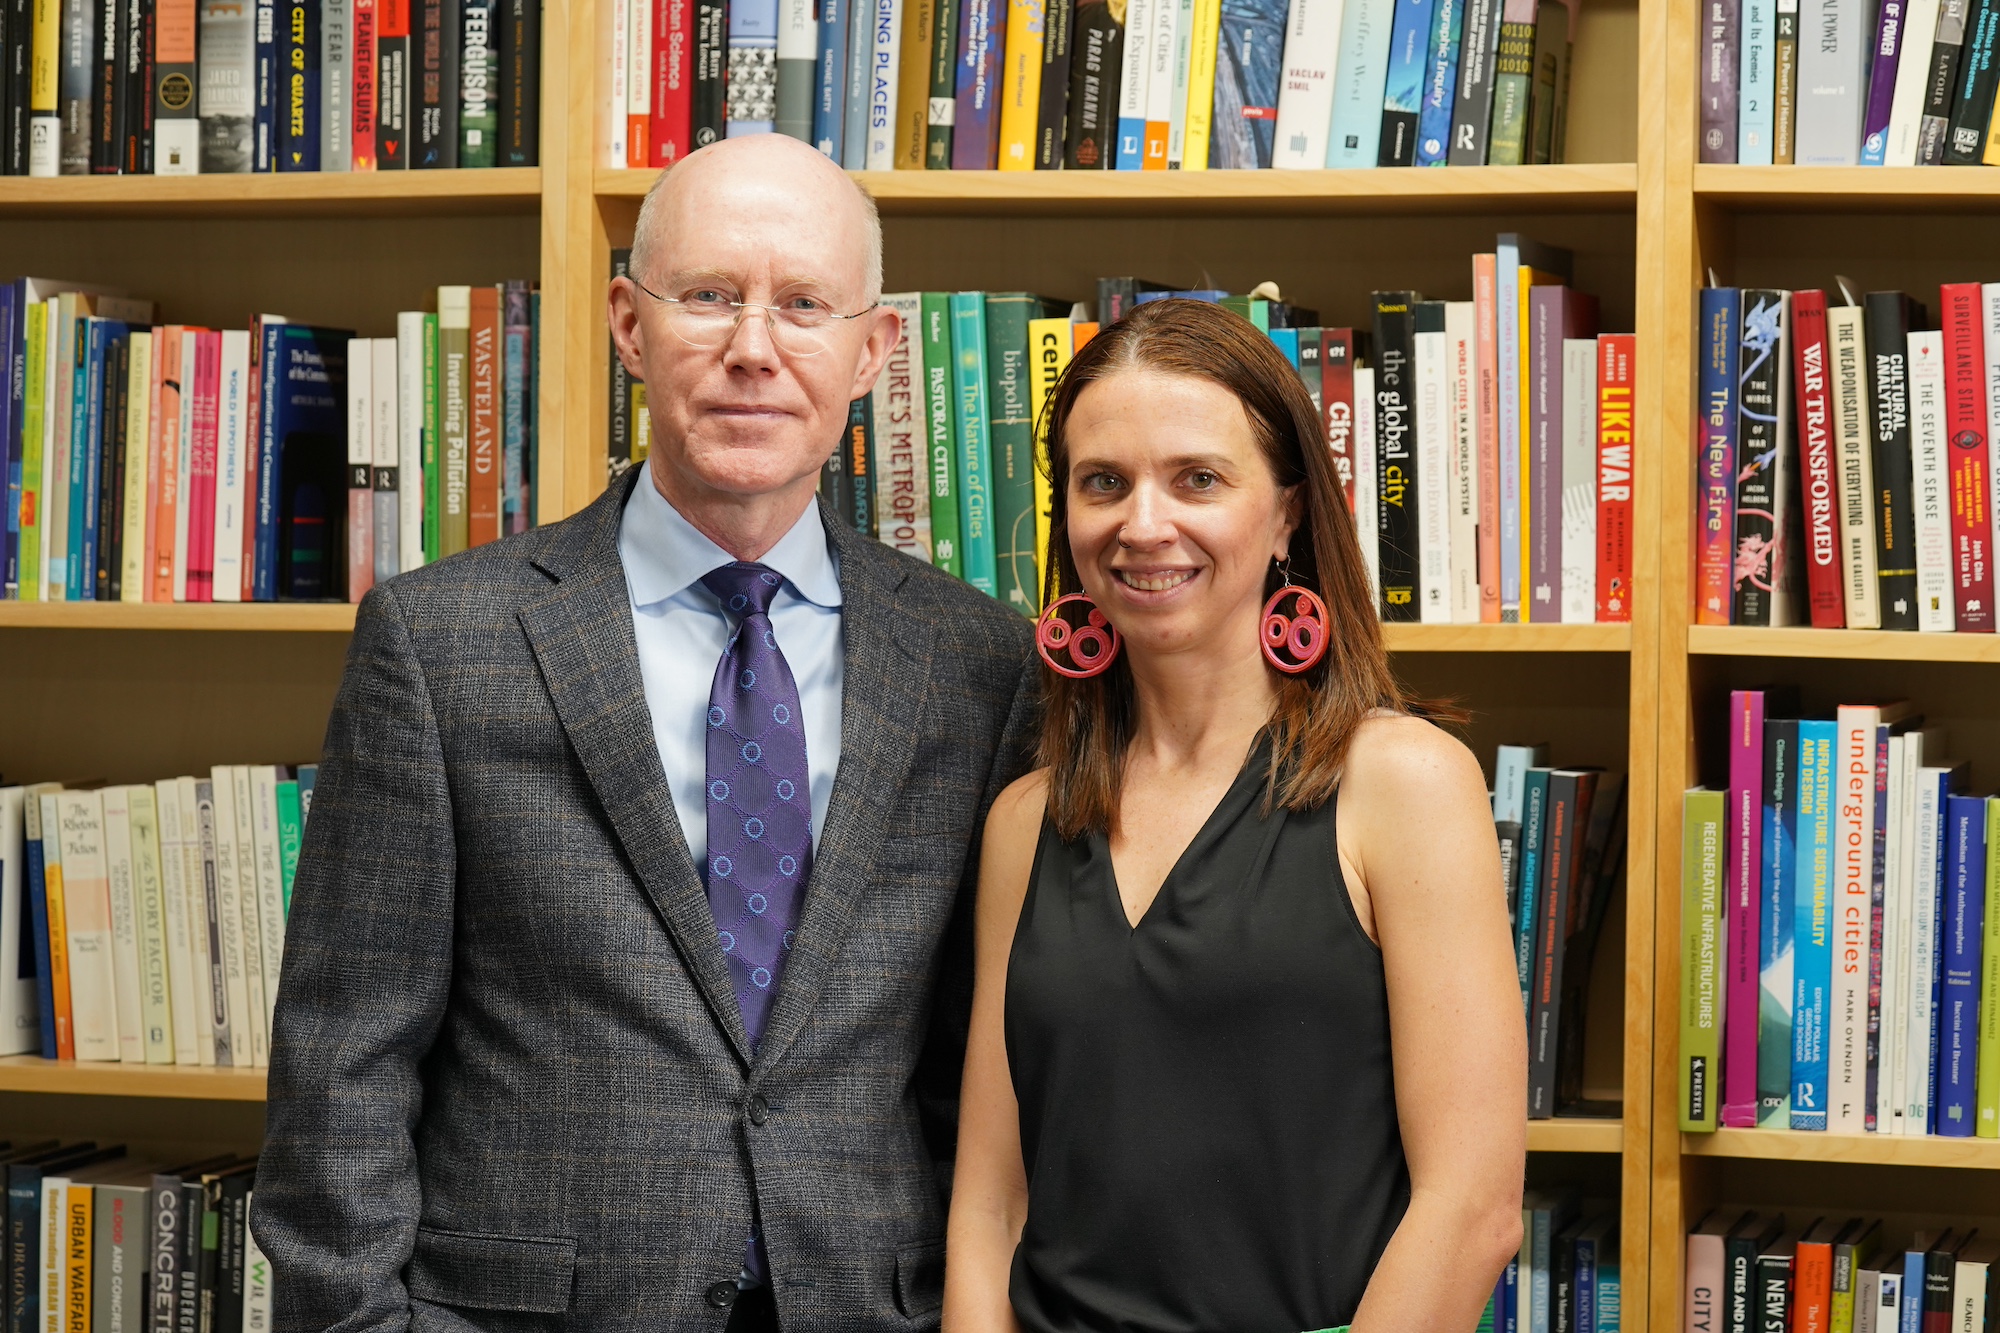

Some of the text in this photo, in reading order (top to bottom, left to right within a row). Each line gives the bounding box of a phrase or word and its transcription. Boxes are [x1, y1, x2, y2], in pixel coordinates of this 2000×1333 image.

[71, 18, 82, 67] NATURE
[129, 29, 141, 73] Societies
[710, 8, 722, 78] MICHAEL BATTY
[918, 10, 929, 42] March
[966, 21, 977, 66] Come of Age
[976, 41, 987, 74] Theories
[1156, 18, 1170, 72] of Cities
[1711, 3, 1724, 109] and Its Enemies 1
[1749, 6, 1762, 112] and Its Enemies 2
[1822, 14, 1837, 52] POWER
[1880, 3, 1900, 56] OF POWER
[1980, 12, 1998, 70] Matthias Ruth
[208, 70, 239, 85] JARED
[292, 7, 303, 136] CITY OF QUARTZ
[329, 24, 342, 151] FEAR MIKE DAVIS
[356, 13, 371, 133] PLANET OF SLUMS
[465, 8, 487, 117] FERGUSON
[669, 32, 683, 89] Science
[823, 49, 833, 112] MICHAEL BATTY
[873, 52, 889, 128] PLACES
[1083, 29, 1103, 129] PARAG KHANNA
[1127, 34, 1145, 109] Expansion
[1351, 65, 1366, 101] West
[1431, 60, 1446, 107] Inquiry
[431, 108, 440, 135] Nicole
[975, 87, 984, 109] Cities
[1779, 45, 1790, 156] The Poverty of Historicism
[1925, 55, 1950, 160] LATOUR OXFORD
[910, 111, 923, 163] Cambridge
[1043, 128, 1052, 164] OXFORD
[13, 355, 23, 400] MAKING
[999, 350, 1022, 425] biopolis
[1617, 354, 1626, 381] SINGER
[1803, 342, 1822, 393] WAR
[1890, 354, 1905, 430] CULTURAL
[1954, 296, 1975, 422] SURVEILLANCE STATE
[226, 370, 237, 486] WORLD HYPOTHESES
[476, 327, 492, 473] WASTELAND
[614, 361, 626, 443] MODERN CITY
[1328, 402, 1350, 453] City
[1378, 350, 1409, 506] the global city
[1458, 340, 1469, 515] WORLD CITIES IN A WORLD-SYSTEM
[1710, 388, 1727, 426] The
[1876, 355, 1892, 441] ANALYTICS
[1921, 384, 1932, 406] THE
[202, 395, 215, 477] THE IMAGE
[446, 354, 464, 514] Inventing Pollution
[852, 426, 865, 474] URBAN
[931, 367, 949, 497] PASTORAL CITIES
[964, 383, 984, 538] The Nature of Cities
[1361, 399, 1371, 473] GLOBAL CITIES
[1482, 369, 1495, 537] urbanism in the age of climate change
[1600, 388, 1630, 501] LIKEWAR
[1709, 435, 1727, 477] New
[1838, 323, 1863, 600] THE WEAPONISATION OF EVERYTHING MARK GALEOTTI
[1922, 414, 1936, 469] SEVENTH
[1708, 487, 1726, 531] Fire
[1806, 395, 1831, 565] TRANSFORMED
[1925, 479, 1937, 519] SENSE
[1884, 507, 1893, 549] MANOVICH
[1972, 540, 1983, 581] Josh Chin
[1961, 553, 1971, 571] Liza
[1962, 574, 1971, 587] Lin
[1801, 738, 1814, 814] AND DESIGN
[1740, 790, 1750, 907] LANDSCAPE INFRASTRUCTURE
[1812, 739, 1829, 945] INFRASTRUCTURE SUSTAINABILITY
[1518, 787, 1540, 982] QUESTIONING ARCHITECTURAL JUDGMENT
[1844, 729, 1868, 1083] underground cities MARK OVENDEN
[1955, 817, 1969, 954] Metabolism of the Anthroposphere
[145, 876, 162, 1006] STORY FACTOR
[1699, 822, 1715, 1028] REGENERATIVE INFRASTRUCTURES
[1950, 1001, 1962, 1084] Baccini and Brunner
[1693, 1072, 1703, 1115] PRESTEL
[47, 1189, 59, 1311] Understanding URBAN
[72, 1204, 84, 1259] URBAN
[112, 1199, 123, 1273] BLOOD AND
[234, 1223, 242, 1245] AND
[14, 1242, 25, 1315] DRAGONS
[232, 1270, 240, 1294] CITY
[1535, 1276, 1547, 1324] AFFAIRS
[1599, 1283, 1620, 1325] GLOBAL
[1694, 1287, 1711, 1331] CITY
[1734, 1256, 1745, 1321] CITIES AND
[1766, 1279, 1784, 1320] NEW
